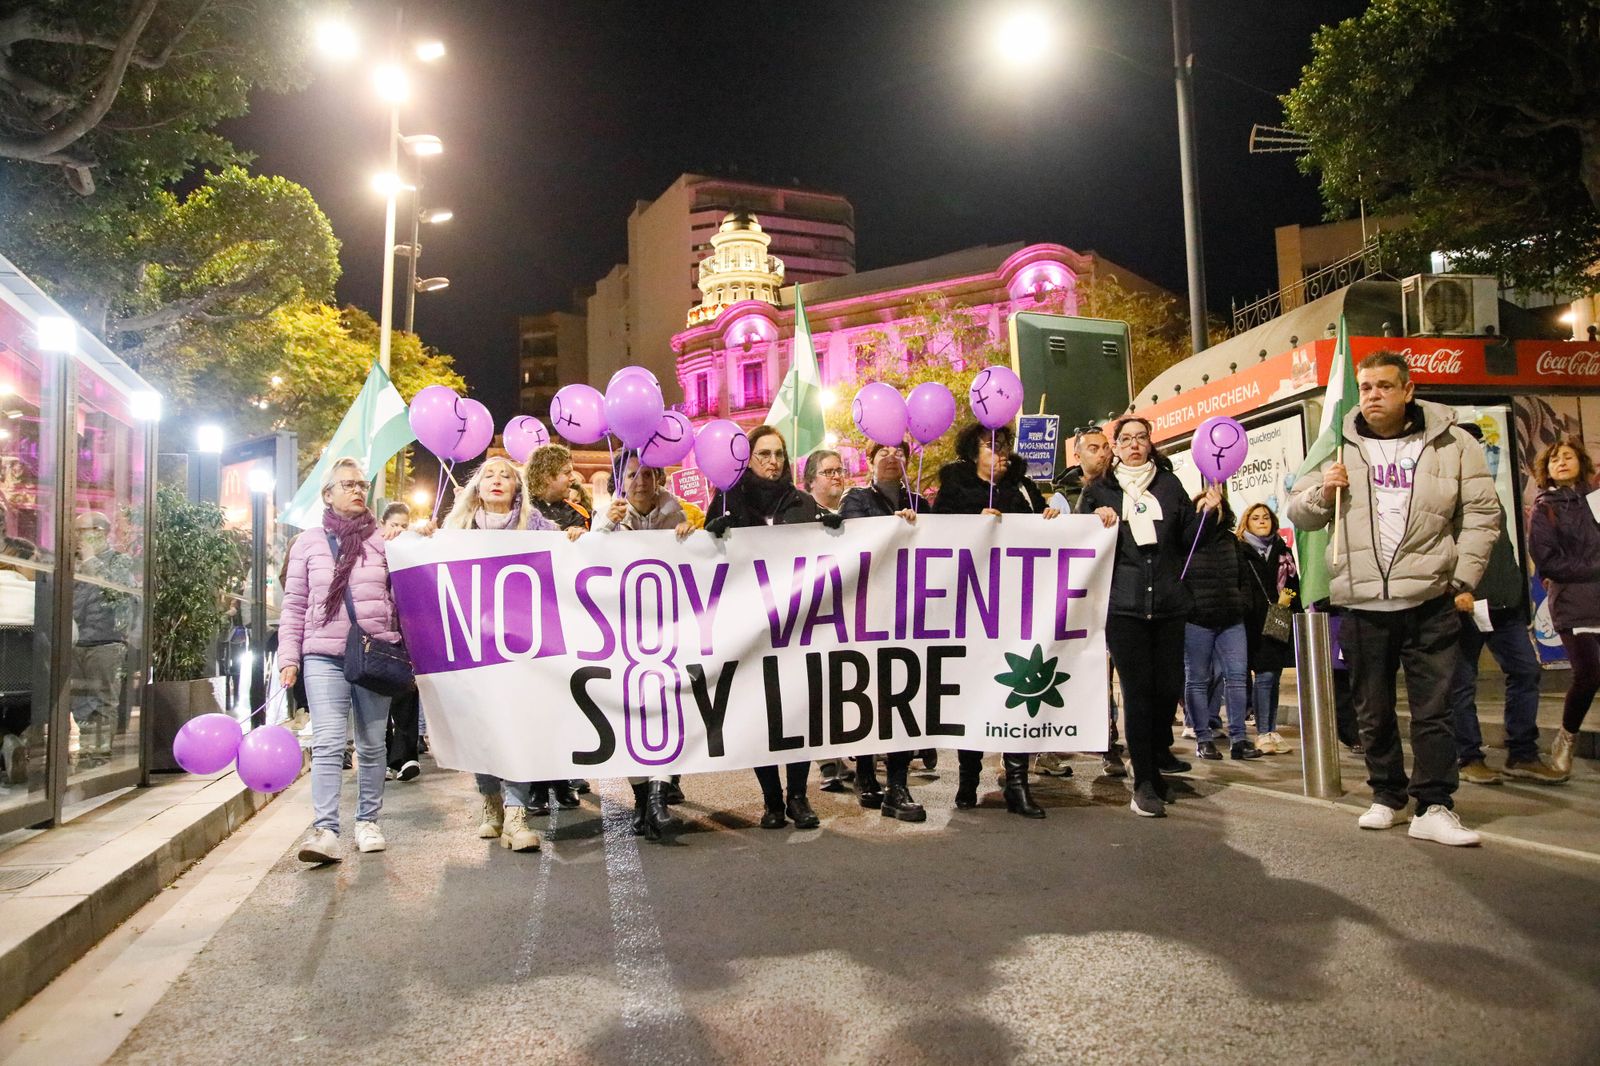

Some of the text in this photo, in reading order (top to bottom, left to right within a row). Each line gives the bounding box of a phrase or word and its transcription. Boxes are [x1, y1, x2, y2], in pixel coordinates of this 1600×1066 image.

[1157, 407, 1195, 432] PUERTA
[1197, 381, 1260, 417] PURCHENA
[1249, 428, 1281, 446] quickgold
[1232, 473, 1273, 492] DE JOYAS
[437, 547, 1096, 663] NO SOY VALIENTE
[569, 645, 967, 766] SOY LIBRE
[985, 721, 1077, 739] iniciativa
